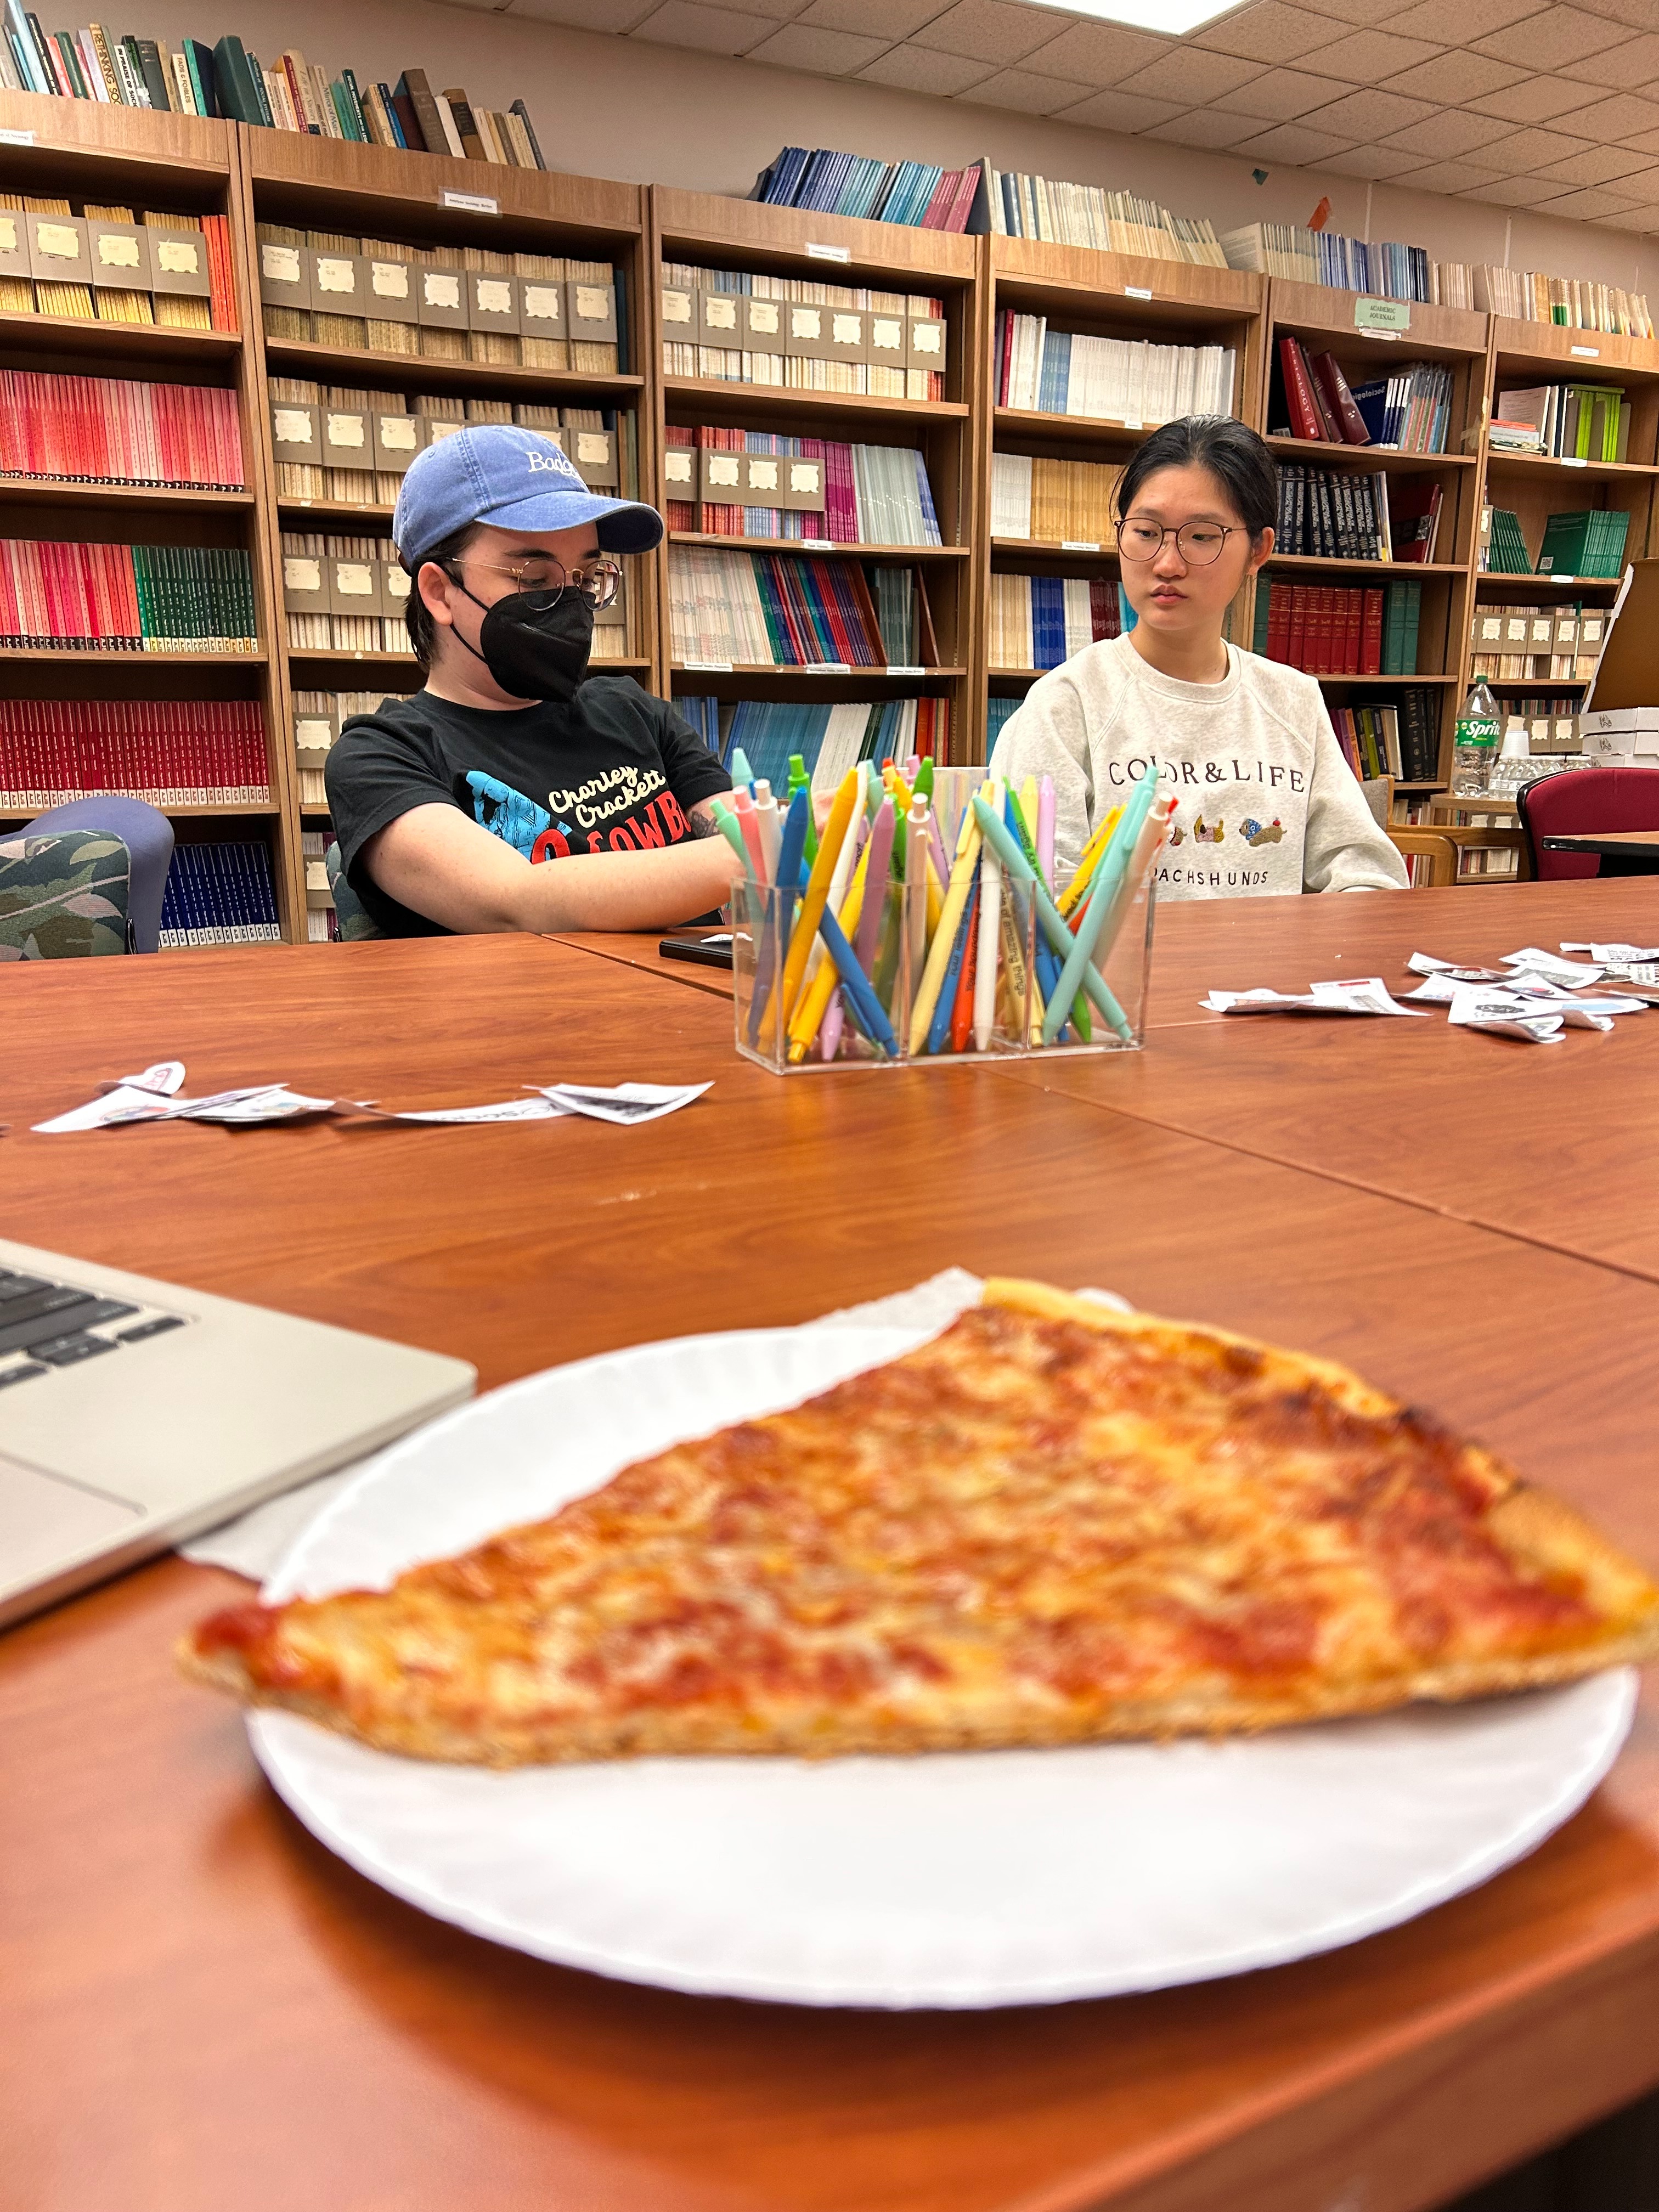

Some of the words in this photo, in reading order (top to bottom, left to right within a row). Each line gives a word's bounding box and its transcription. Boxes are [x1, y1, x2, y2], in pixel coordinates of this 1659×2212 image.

[120, 56, 129, 79] PRAISE
[1369, 312, 1396, 321] JOURNALS
[1370, 306, 1396, 314] ACADEMIC
[525, 452, 583, 479] Badg
[1466, 721, 1499, 738] Sprit
[549, 766, 638, 814] Charley
[576, 770, 666, 828] Crockett
[1154, 868, 1268, 885] ACHSHUNDS
[1003, 921, 1018, 964] amazing
[1012, 966, 1026, 996] things
